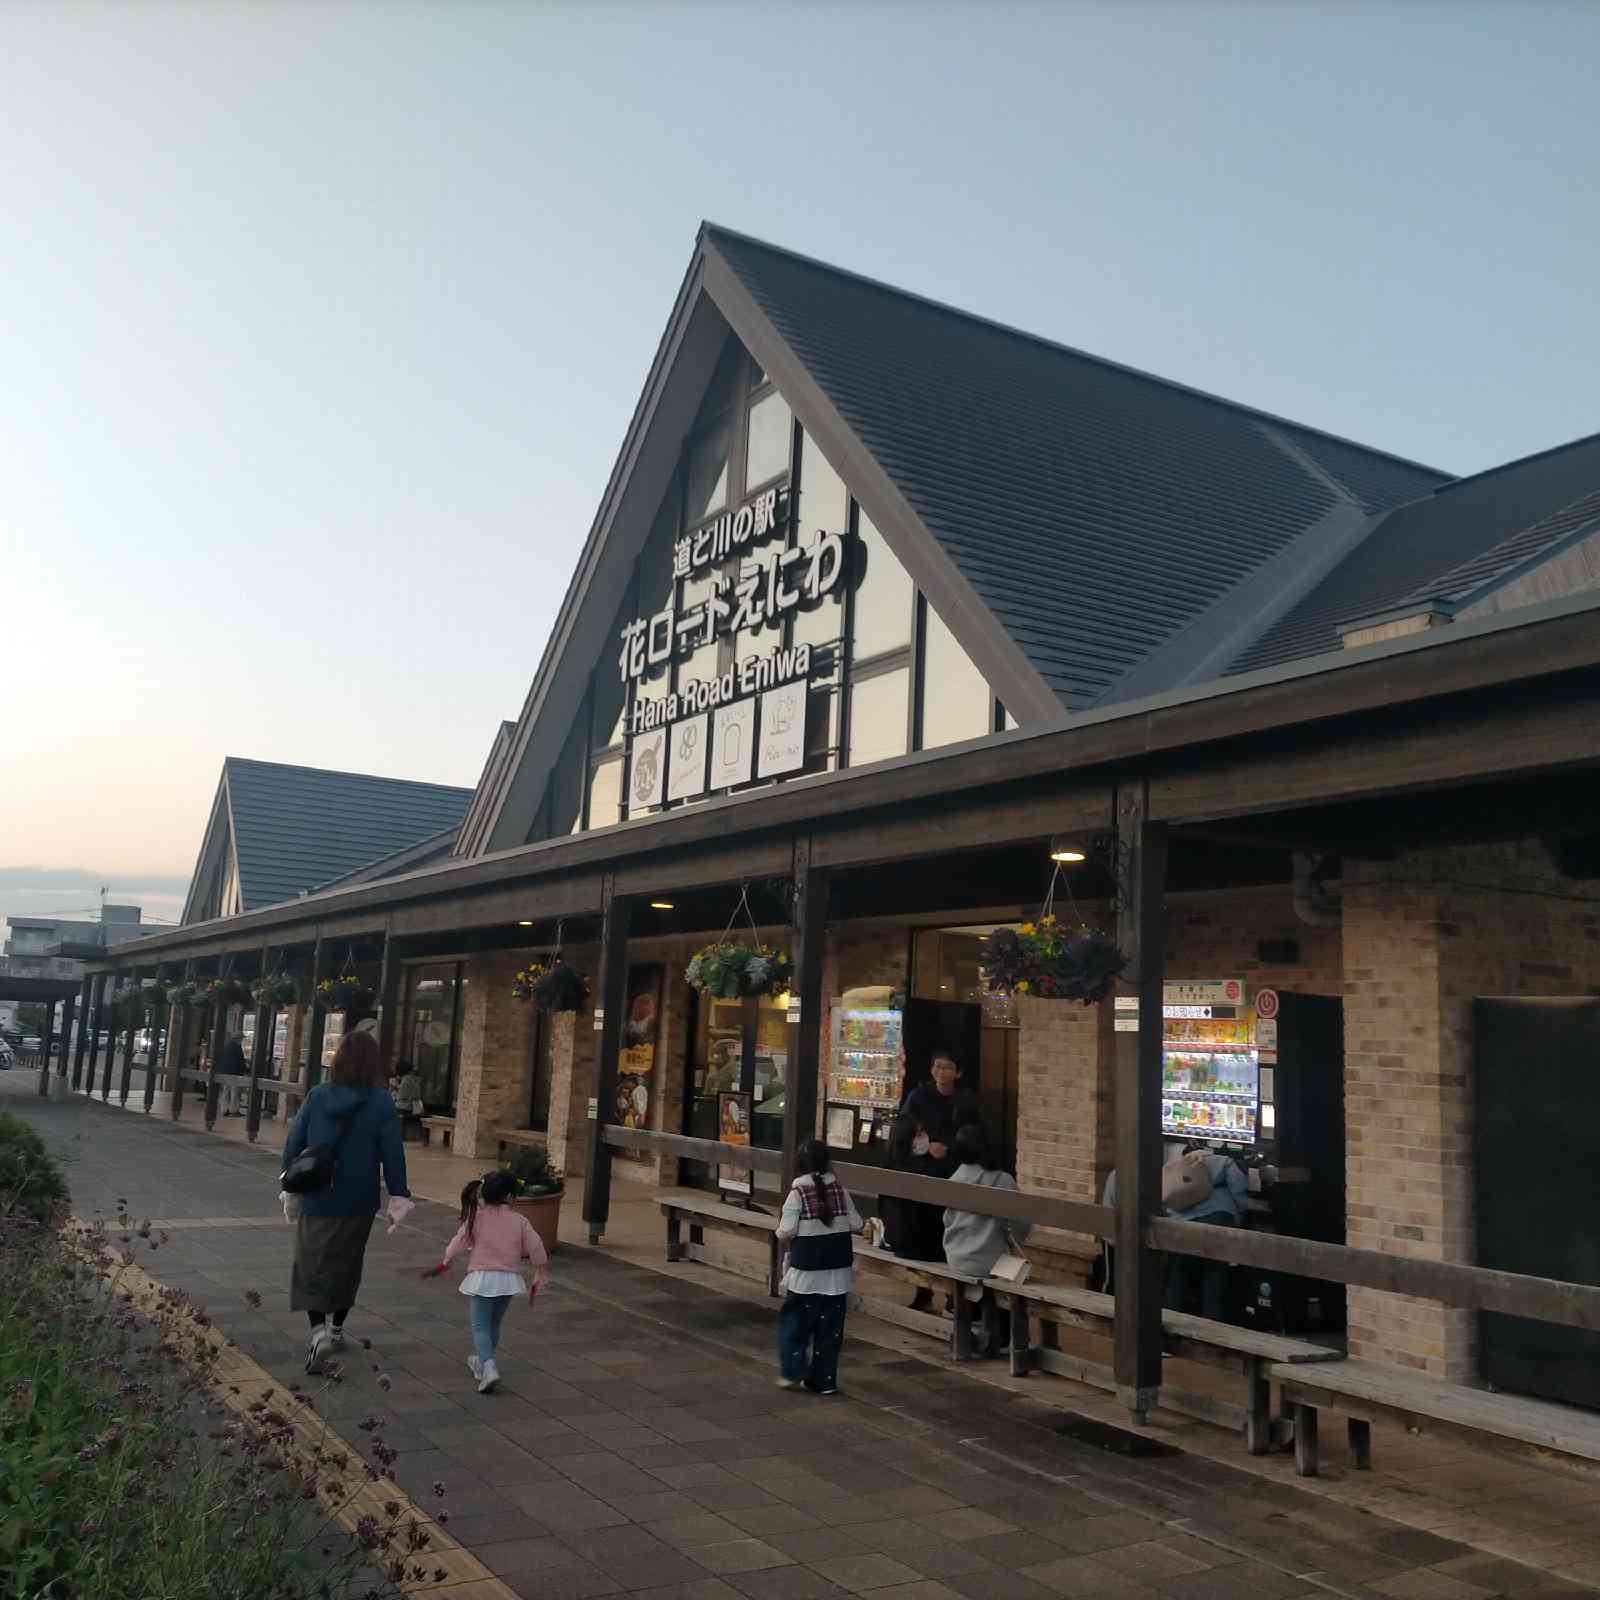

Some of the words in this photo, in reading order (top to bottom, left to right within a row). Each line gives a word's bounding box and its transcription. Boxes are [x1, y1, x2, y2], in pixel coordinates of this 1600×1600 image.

[673, 488, 776, 578] 道と川の駅
[619, 530, 842, 682] 花ロードえにわ
[633, 692, 677, 732] Hana
[684, 664, 734, 714] Road
[741, 644, 810, 693] Eniwa
